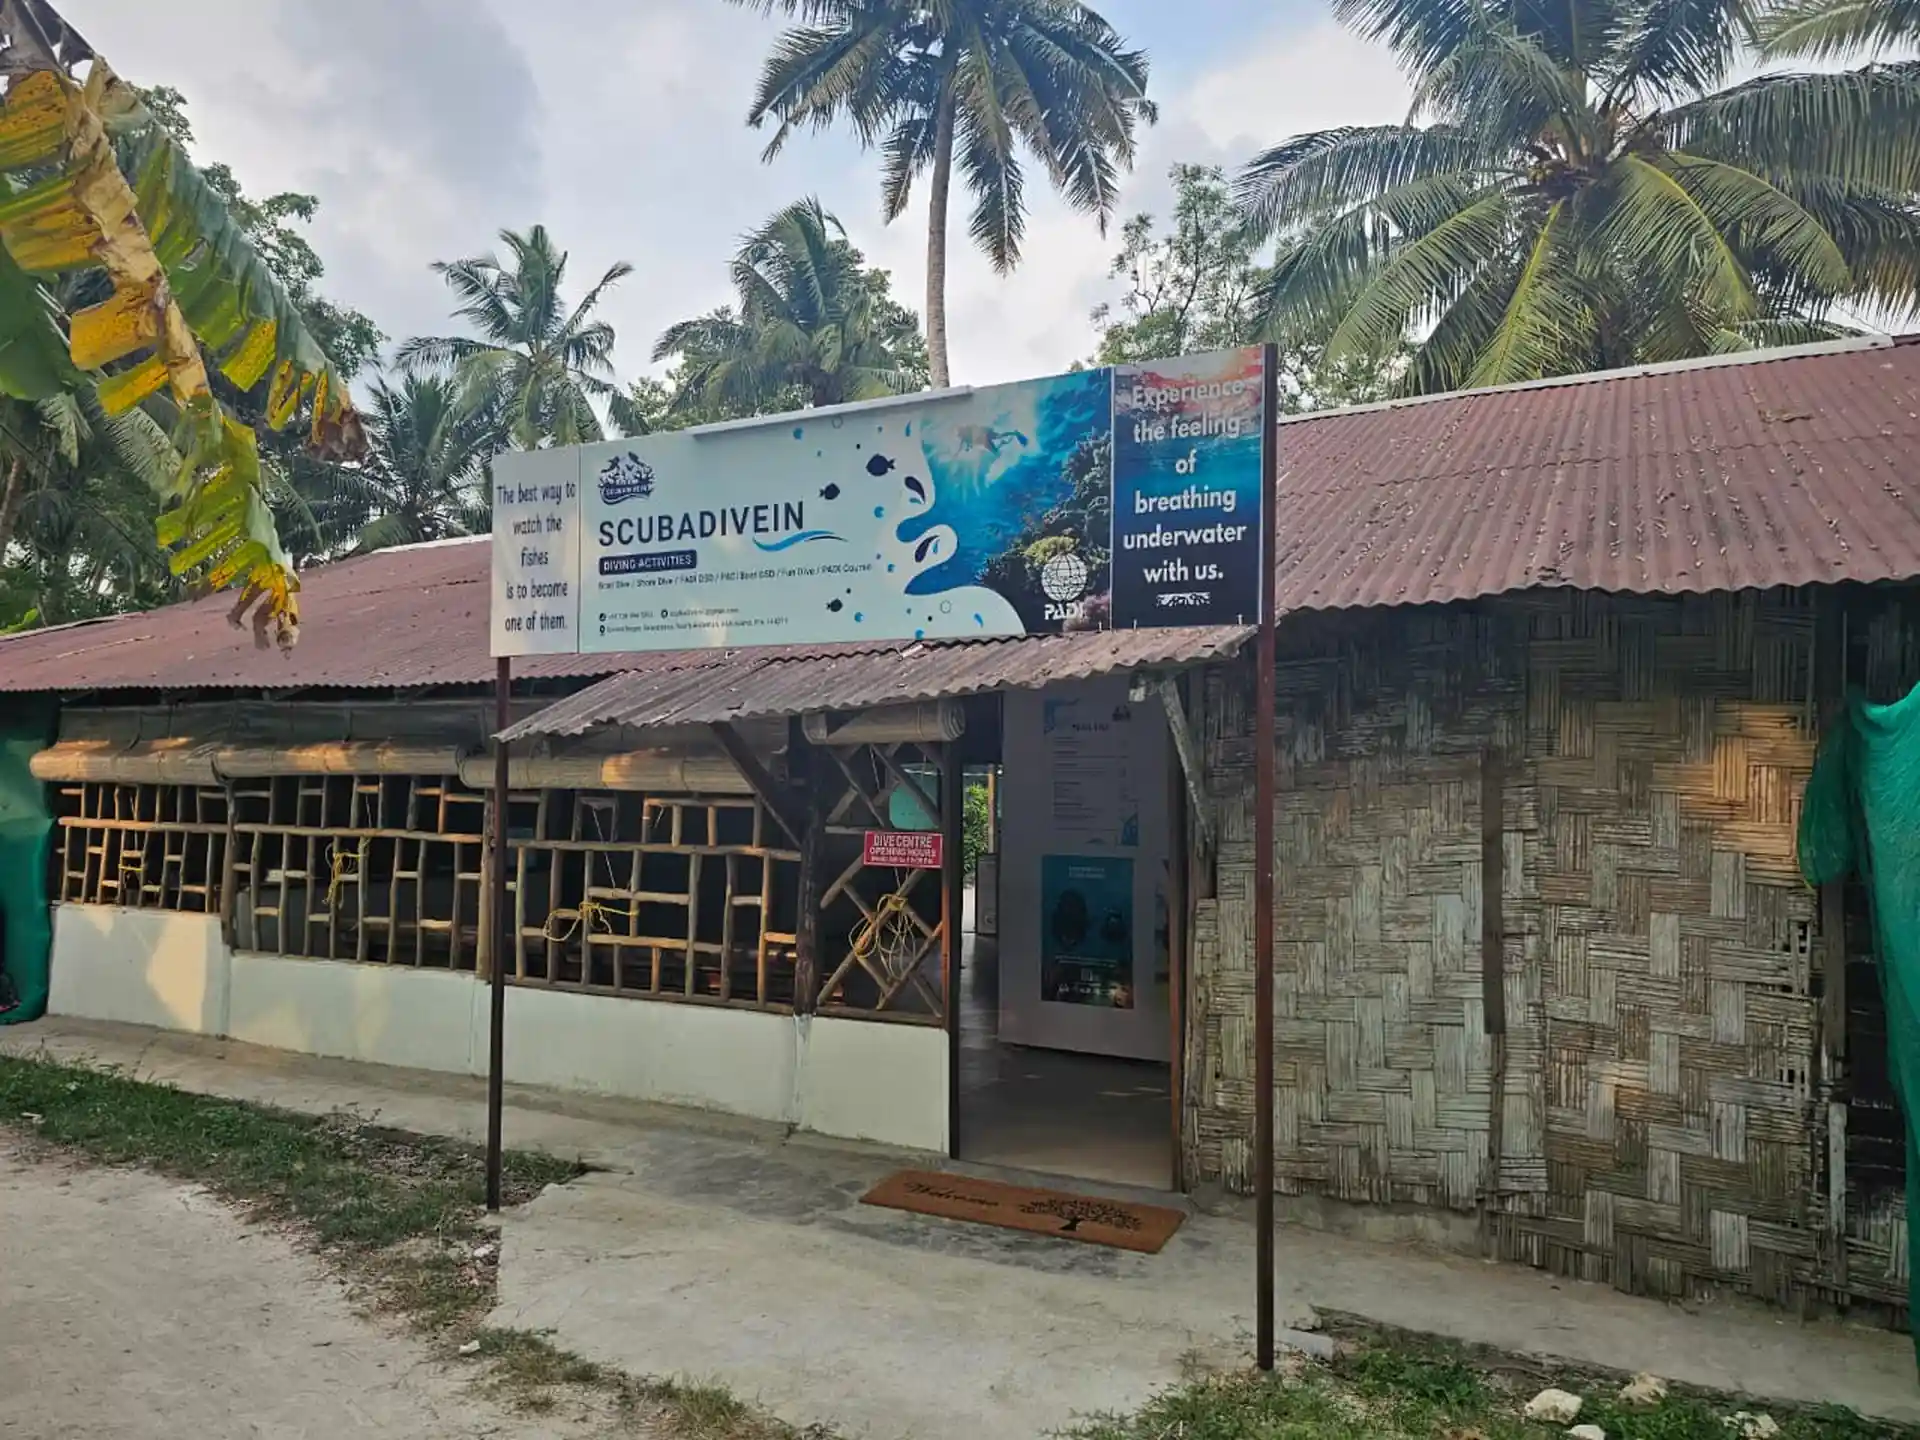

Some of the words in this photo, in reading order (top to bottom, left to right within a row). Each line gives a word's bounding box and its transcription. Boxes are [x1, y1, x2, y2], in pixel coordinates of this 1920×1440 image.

[1131, 379, 1245, 412] Experience
[1133, 419, 1165, 443] the
[1170, 413, 1242, 438] feeling
[1175, 449, 1197, 474] of
[497, 486, 514, 504] The
[518, 483, 538, 504] best
[542, 485, 562, 505] way
[565, 481, 576, 498] to
[1135, 485, 1237, 514] breathing
[513, 513, 542, 534] watch
[546, 513, 562, 532] the
[598, 501, 805, 547] SCUBADIVEIN
[1123, 524, 1247, 550] underwater
[521, 547, 549, 567] fishes
[603, 557, 637, 571] DIVING
[639, 554, 692, 569] ACTIVITIES
[1143, 557, 1189, 583] with
[1195, 563, 1224, 581] us.
[506, 581, 514, 599] is
[517, 584, 528, 598] to
[531, 581, 568, 598] become
[505, 616, 522, 631] one
[526, 612, 537, 631] of
[540, 611, 568, 631] them.
[870, 846, 906, 855] OPENING
[874, 835, 895, 847] DIVE
[896, 836, 932, 848] CENTRE
